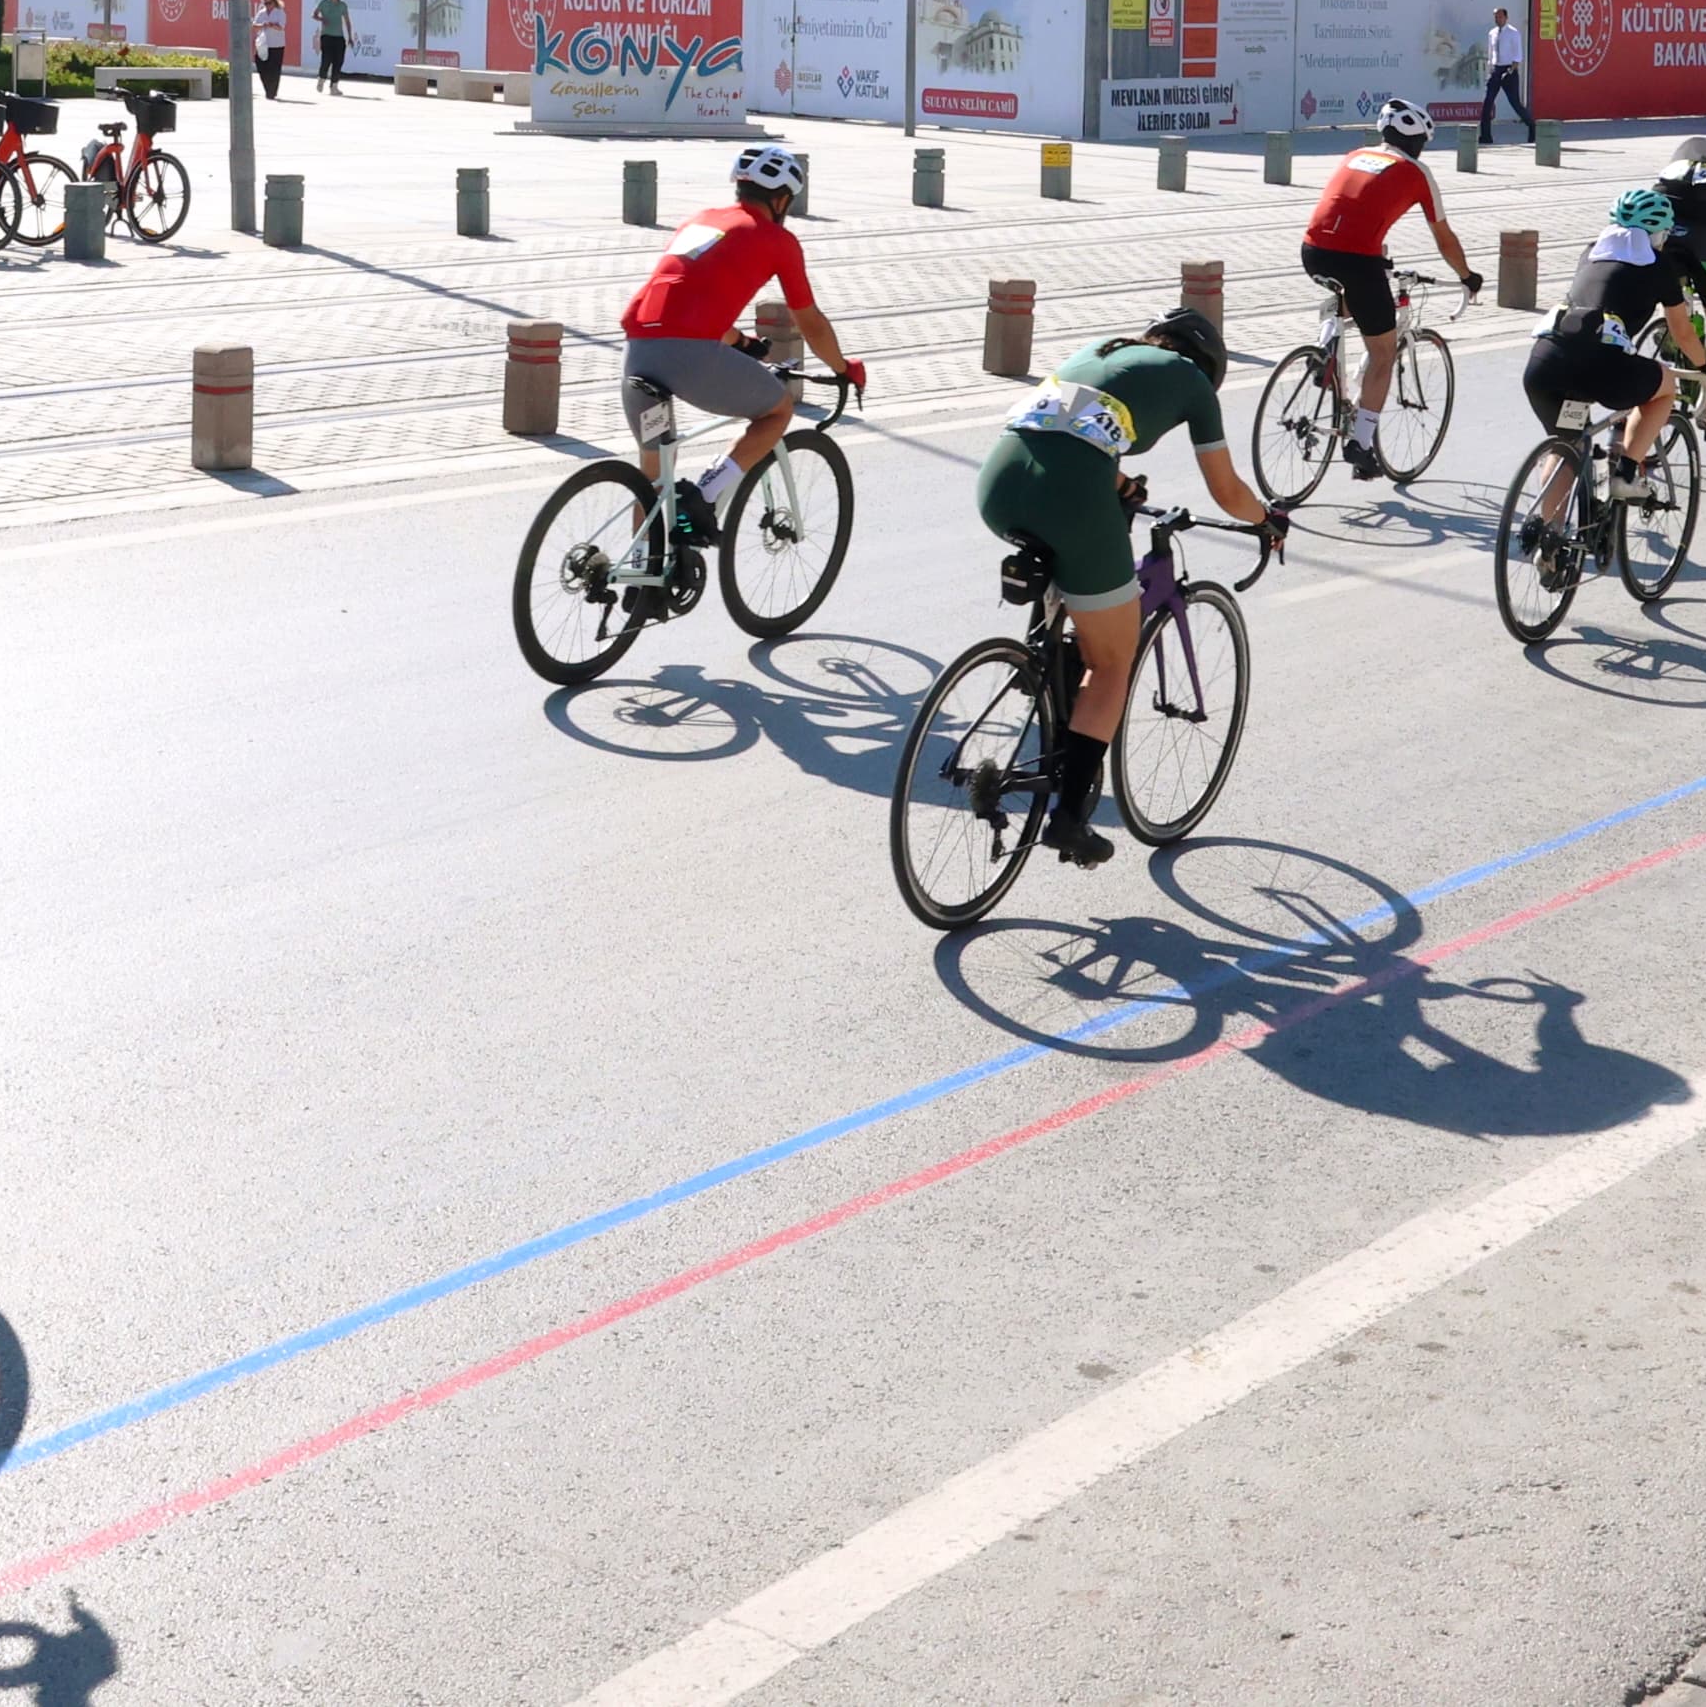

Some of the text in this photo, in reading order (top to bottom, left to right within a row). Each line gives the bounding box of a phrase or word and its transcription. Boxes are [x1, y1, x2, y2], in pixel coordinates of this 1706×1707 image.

[1621, 2, 1684, 33] KÜLTÜR
[594, 19, 677, 48] BAKANLIĞI
[855, 69, 880, 83] VAKIF
[550, 79, 639, 98] Gönüllerin
[684, 86, 702, 100] The
[705, 85, 730, 103] City
[855, 82, 889, 100] KATILIM
[1111, 83, 1234, 108] MEVLANA MÜZESİ GİRİŞİ
[572, 100, 616, 119] Şehri
[696, 103, 730, 118] Hearts
[924, 93, 959, 110] SULTAN
[960, 93, 987, 112] SELİM
[1137, 110, 1210, 132] İLERİDE SOLDA
